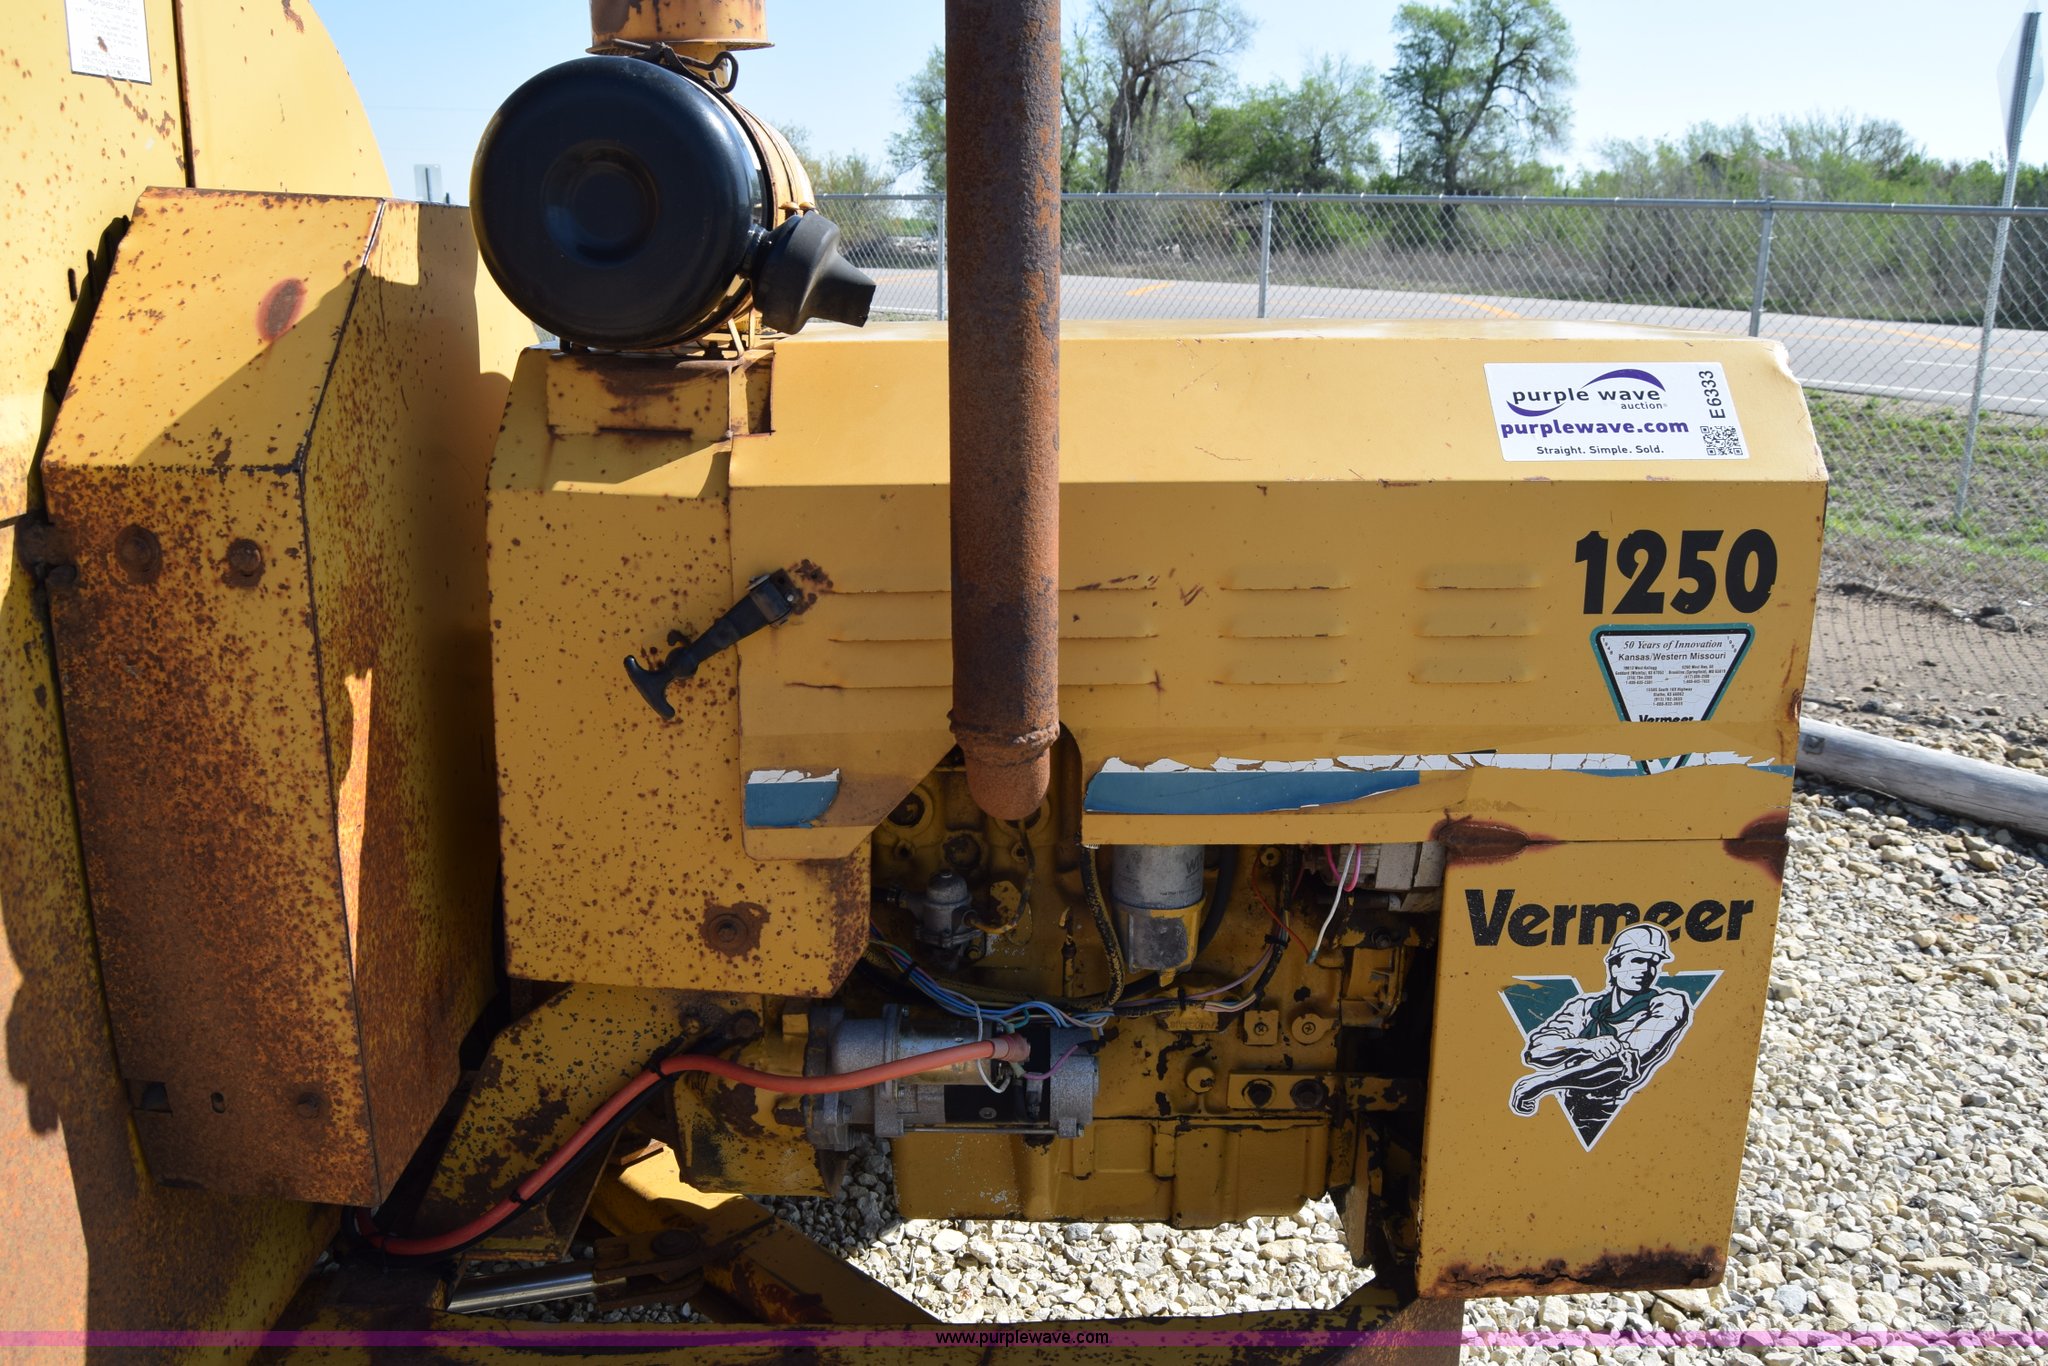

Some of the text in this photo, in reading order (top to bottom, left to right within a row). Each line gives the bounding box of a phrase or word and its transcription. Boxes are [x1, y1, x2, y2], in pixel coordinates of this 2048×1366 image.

[1512, 388, 1660, 404] purple wave
[1699, 370, 1725, 418] E6333
[1620, 402, 1663, 410] auction
[1501, 419, 1689, 438] purplewave.com
[1536, 445, 1664, 456] Straight. Simple. Sold.
[1575, 529, 1777, 614] 1250
[1624, 639, 1723, 651] 50 Years of Innovation
[1690, 651, 1726, 660] Missouri
[1465, 889, 1754, 946] Vermeer
